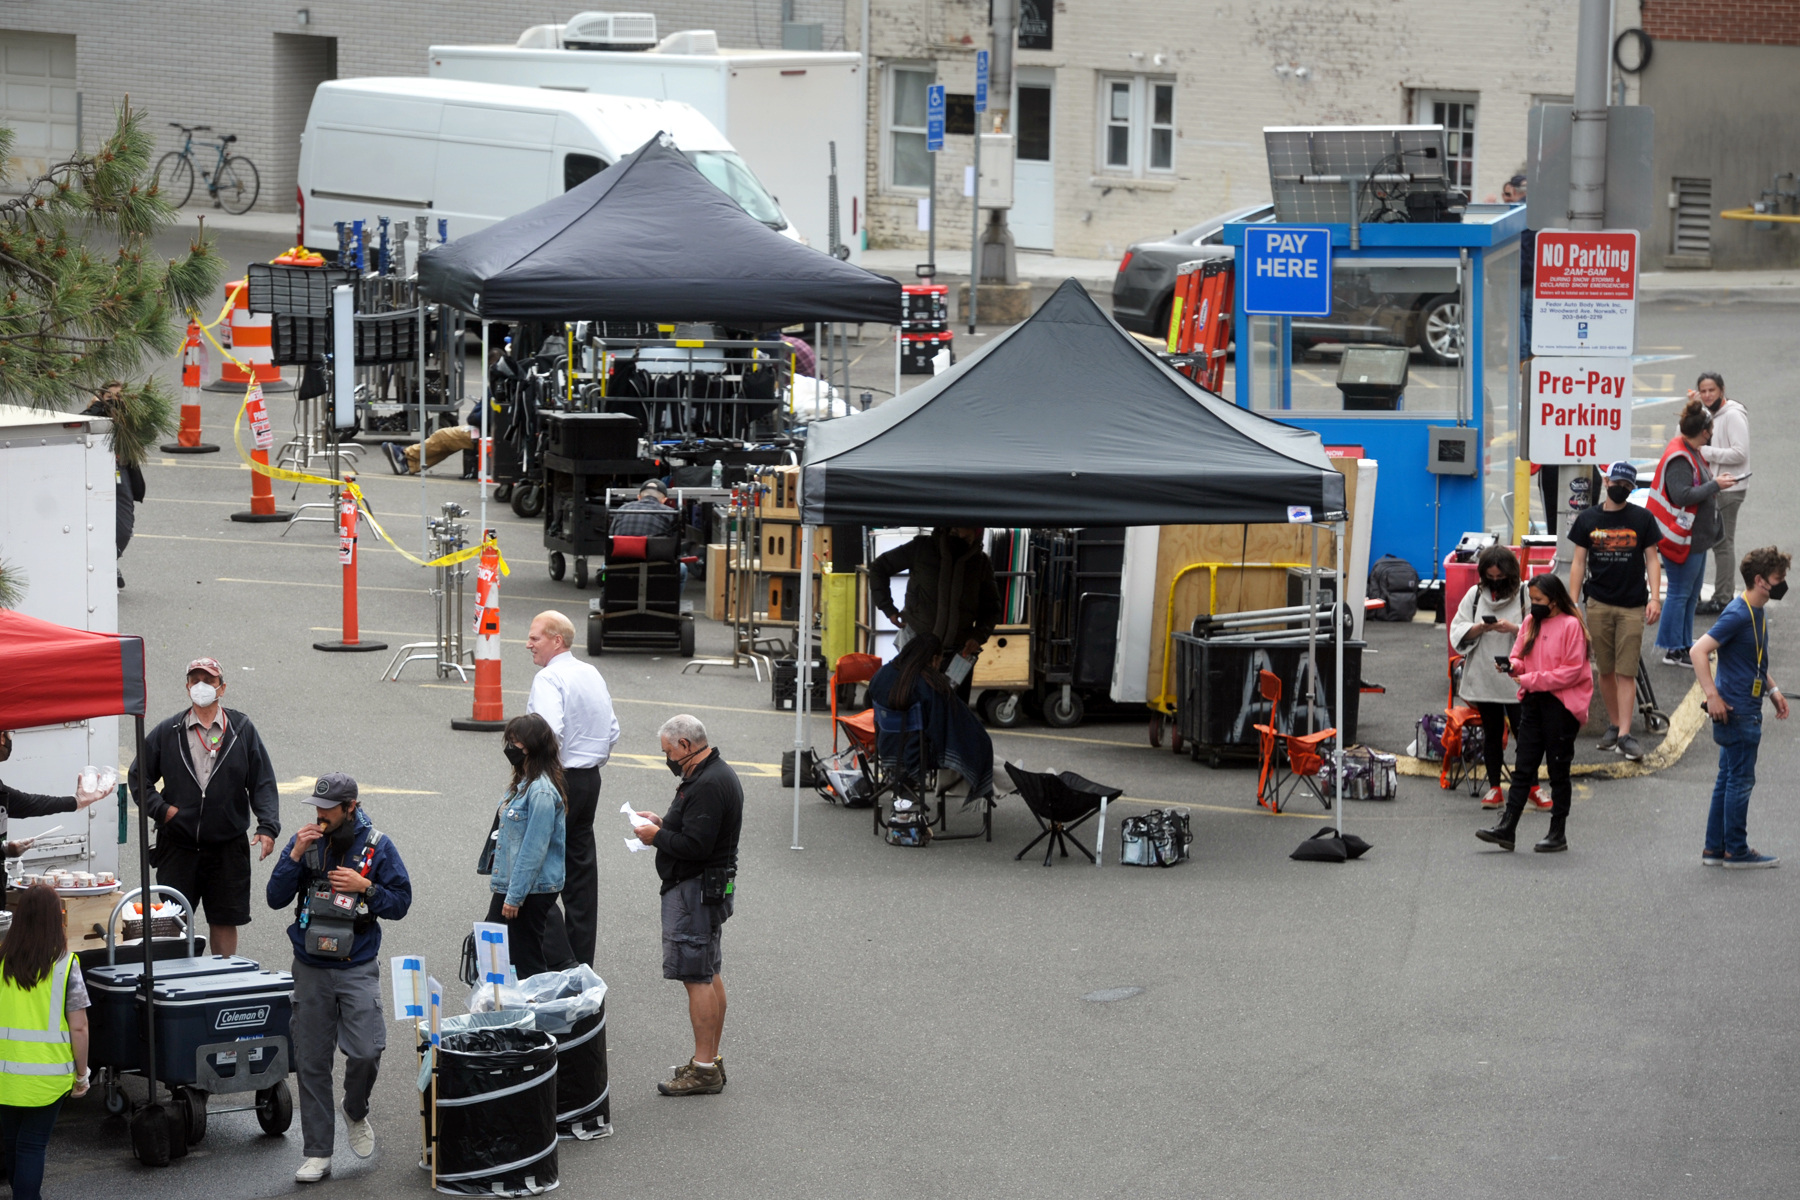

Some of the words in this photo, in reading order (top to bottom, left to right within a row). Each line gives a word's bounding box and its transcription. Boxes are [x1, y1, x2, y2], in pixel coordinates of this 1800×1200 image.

[1267, 234, 1308, 254] PAY
[1256, 258, 1318, 278] HERE
[1542, 244, 1564, 267] NO
[1569, 244, 1630, 272] Parking
[1539, 371, 1625, 398] Pre-Pay
[1541, 403, 1621, 431] Parking
[1564, 434, 1596, 457] Lot
[222, 1010, 256, 1022] Coleman
